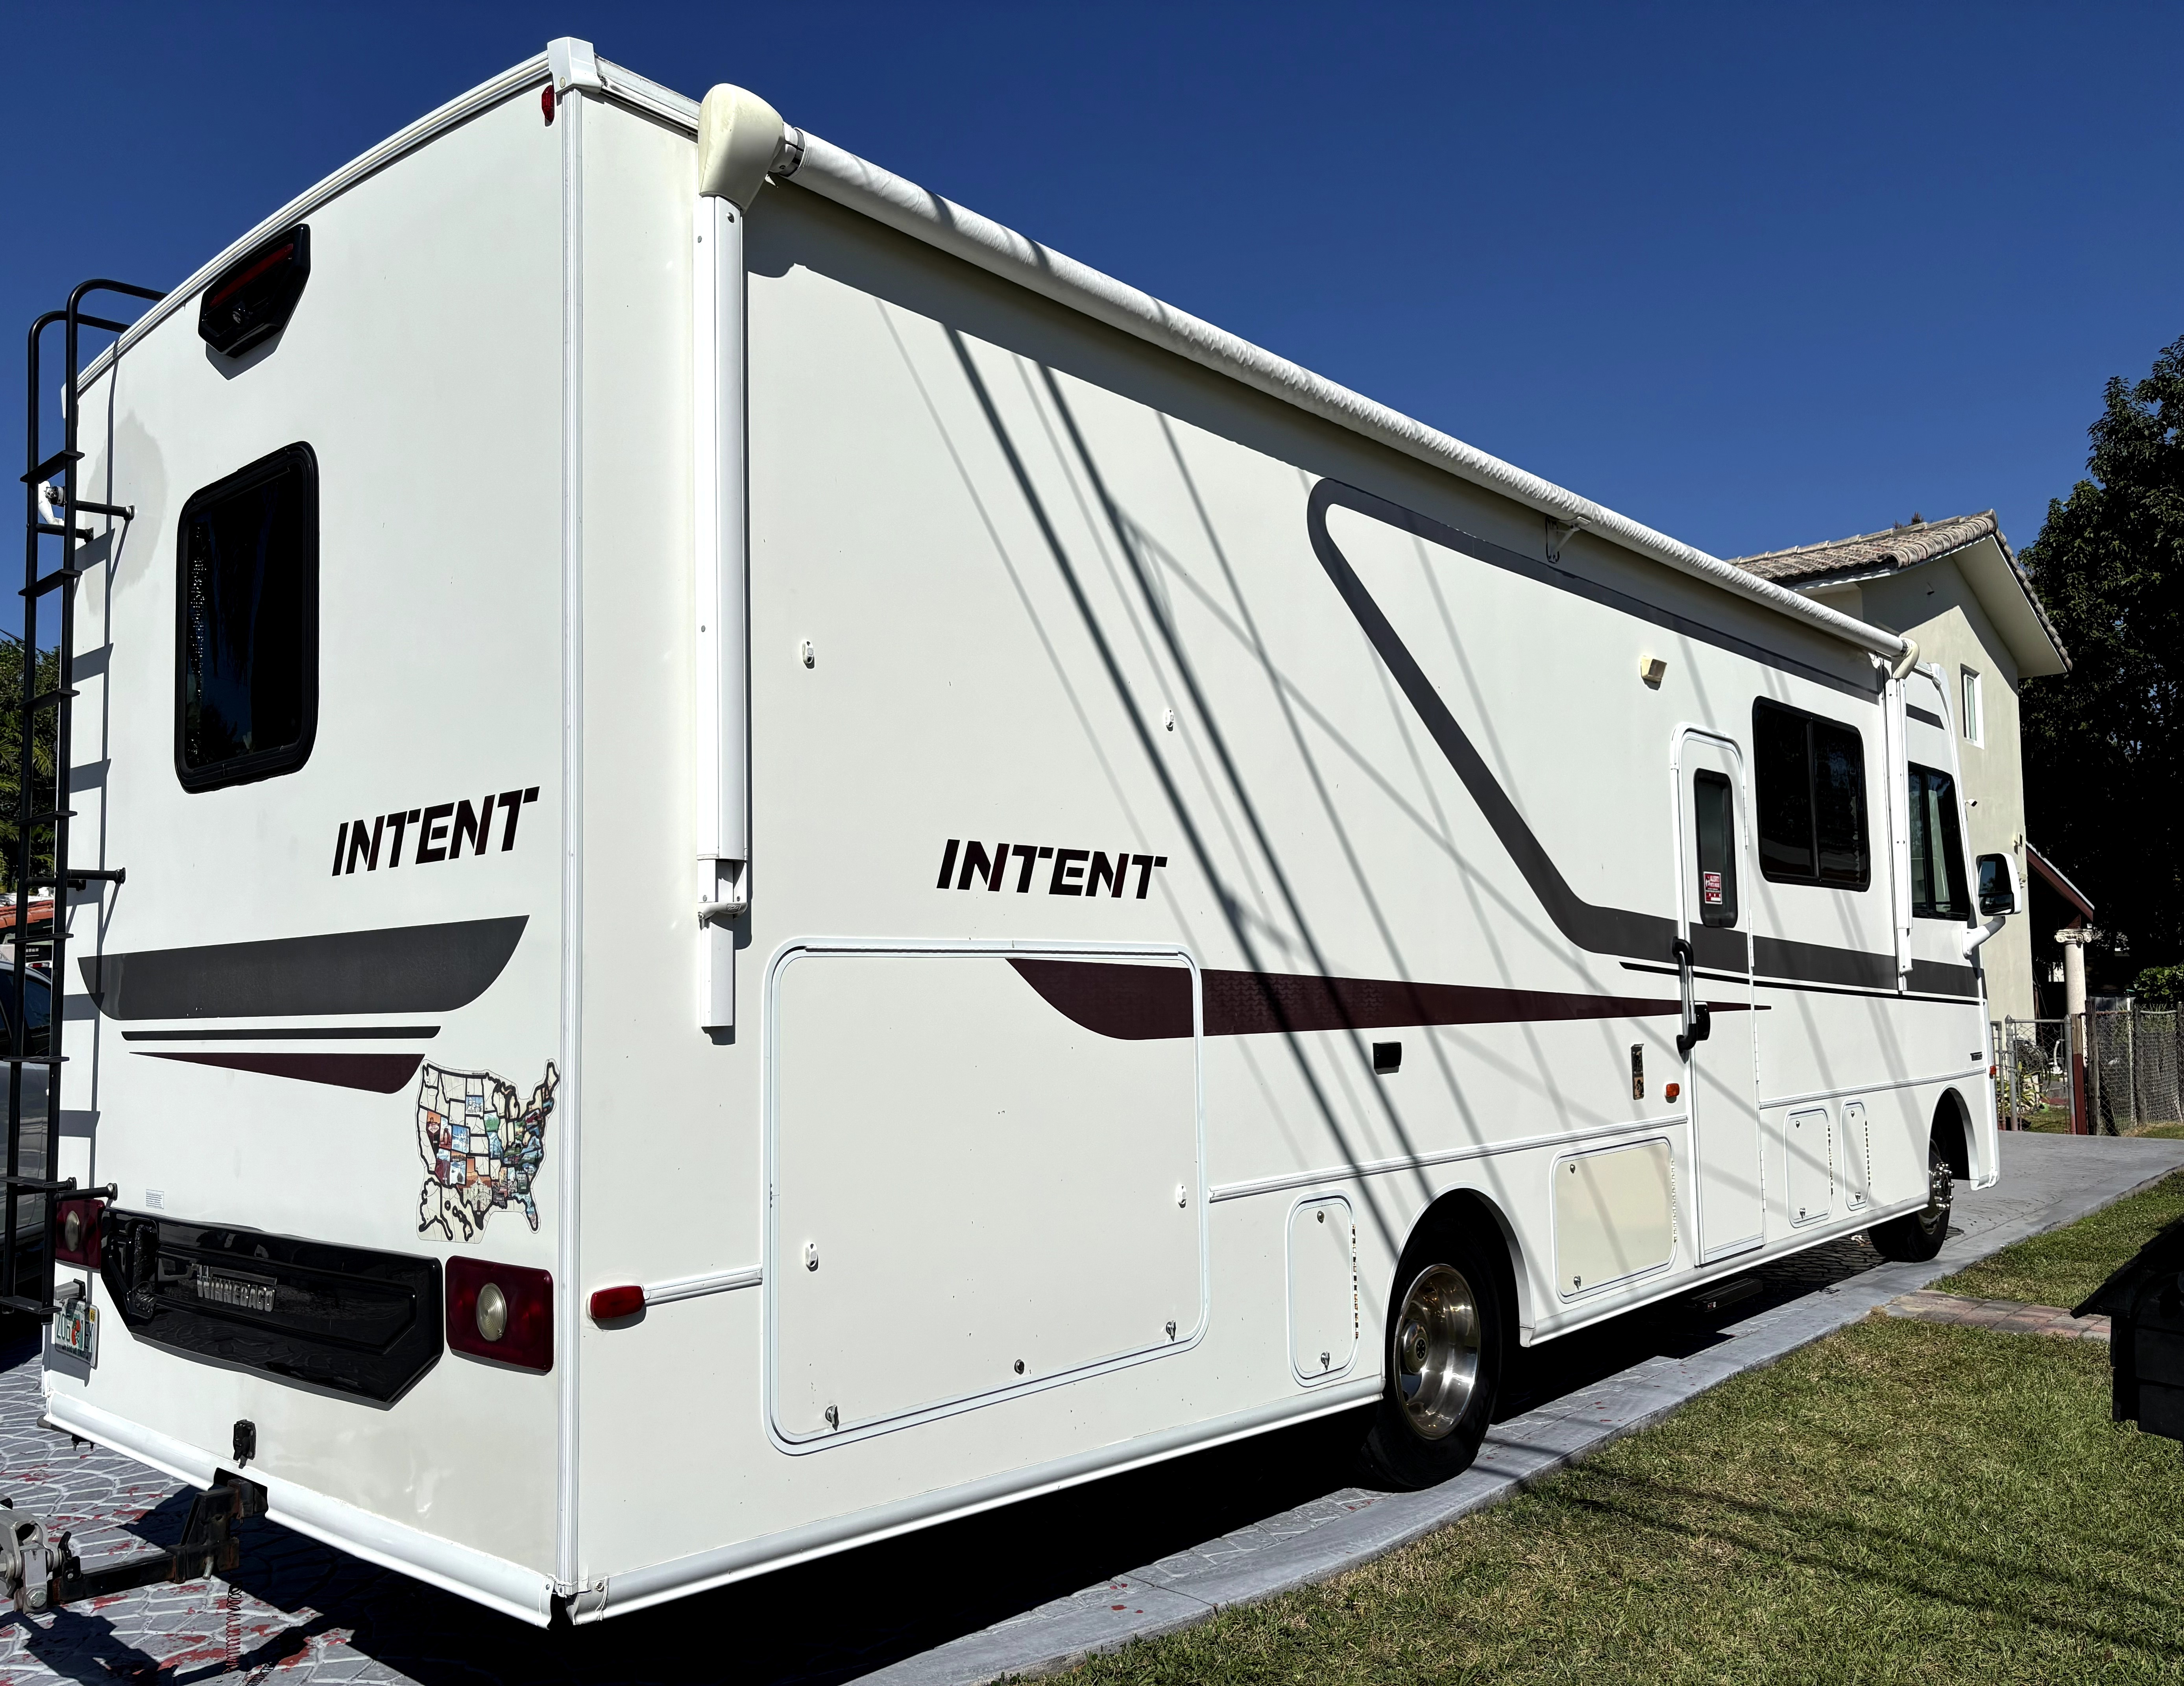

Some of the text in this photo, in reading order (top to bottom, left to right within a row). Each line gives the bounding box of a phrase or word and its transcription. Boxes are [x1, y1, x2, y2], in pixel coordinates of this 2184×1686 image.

[332, 786, 540, 876] INTENT
[937, 839, 1168, 899] INTENT
[192, 1263, 275, 1312] WINNEBAGO
